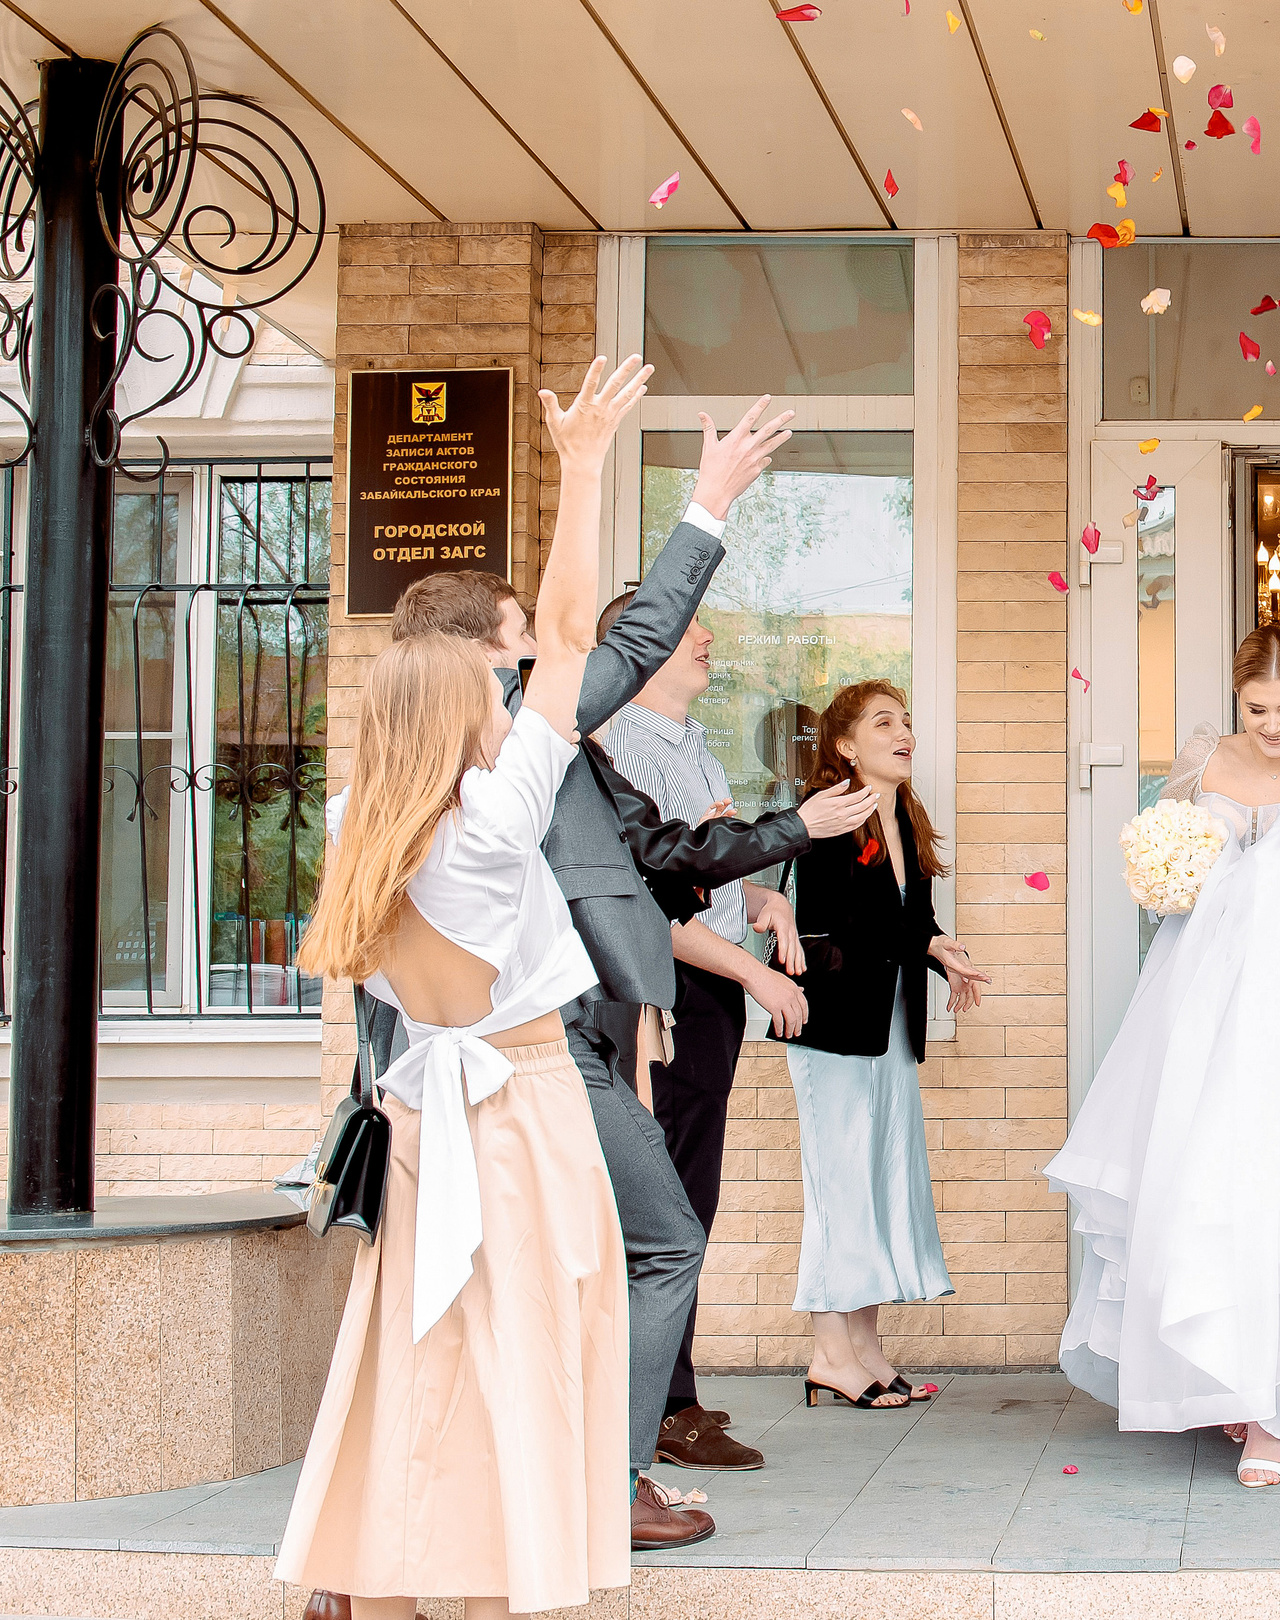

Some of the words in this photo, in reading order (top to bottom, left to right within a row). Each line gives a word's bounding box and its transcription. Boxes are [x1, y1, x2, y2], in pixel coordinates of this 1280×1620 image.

[387, 432, 473, 445] ДЕПАРТАМЕНТ
[386, 448, 433, 457] ЗАПИСИ
[436, 447, 475, 456] АКТОВ
[382, 461, 478, 472] ГРАЖДАНСКОГО
[394, 475, 466, 485] СОСТОЯНИЯ
[359, 488, 467, 500] ЗАБАЙКАЛЬСКОГО
[470, 488, 500, 497] КРАЯ
[373, 520, 485, 540] ГОРОДСКОЙ
[372, 546, 435, 563] ОТДЕЛ
[440, 545, 486, 559] ЗАГС
[738, 635, 781, 645] РЕЖИМ
[787, 635, 836, 645] РАБОТЫ
[707, 672, 732, 681] орник
[698, 696, 730, 705] Четверг
[707, 738, 731, 748] ббота
[791, 735, 818, 743] регист
